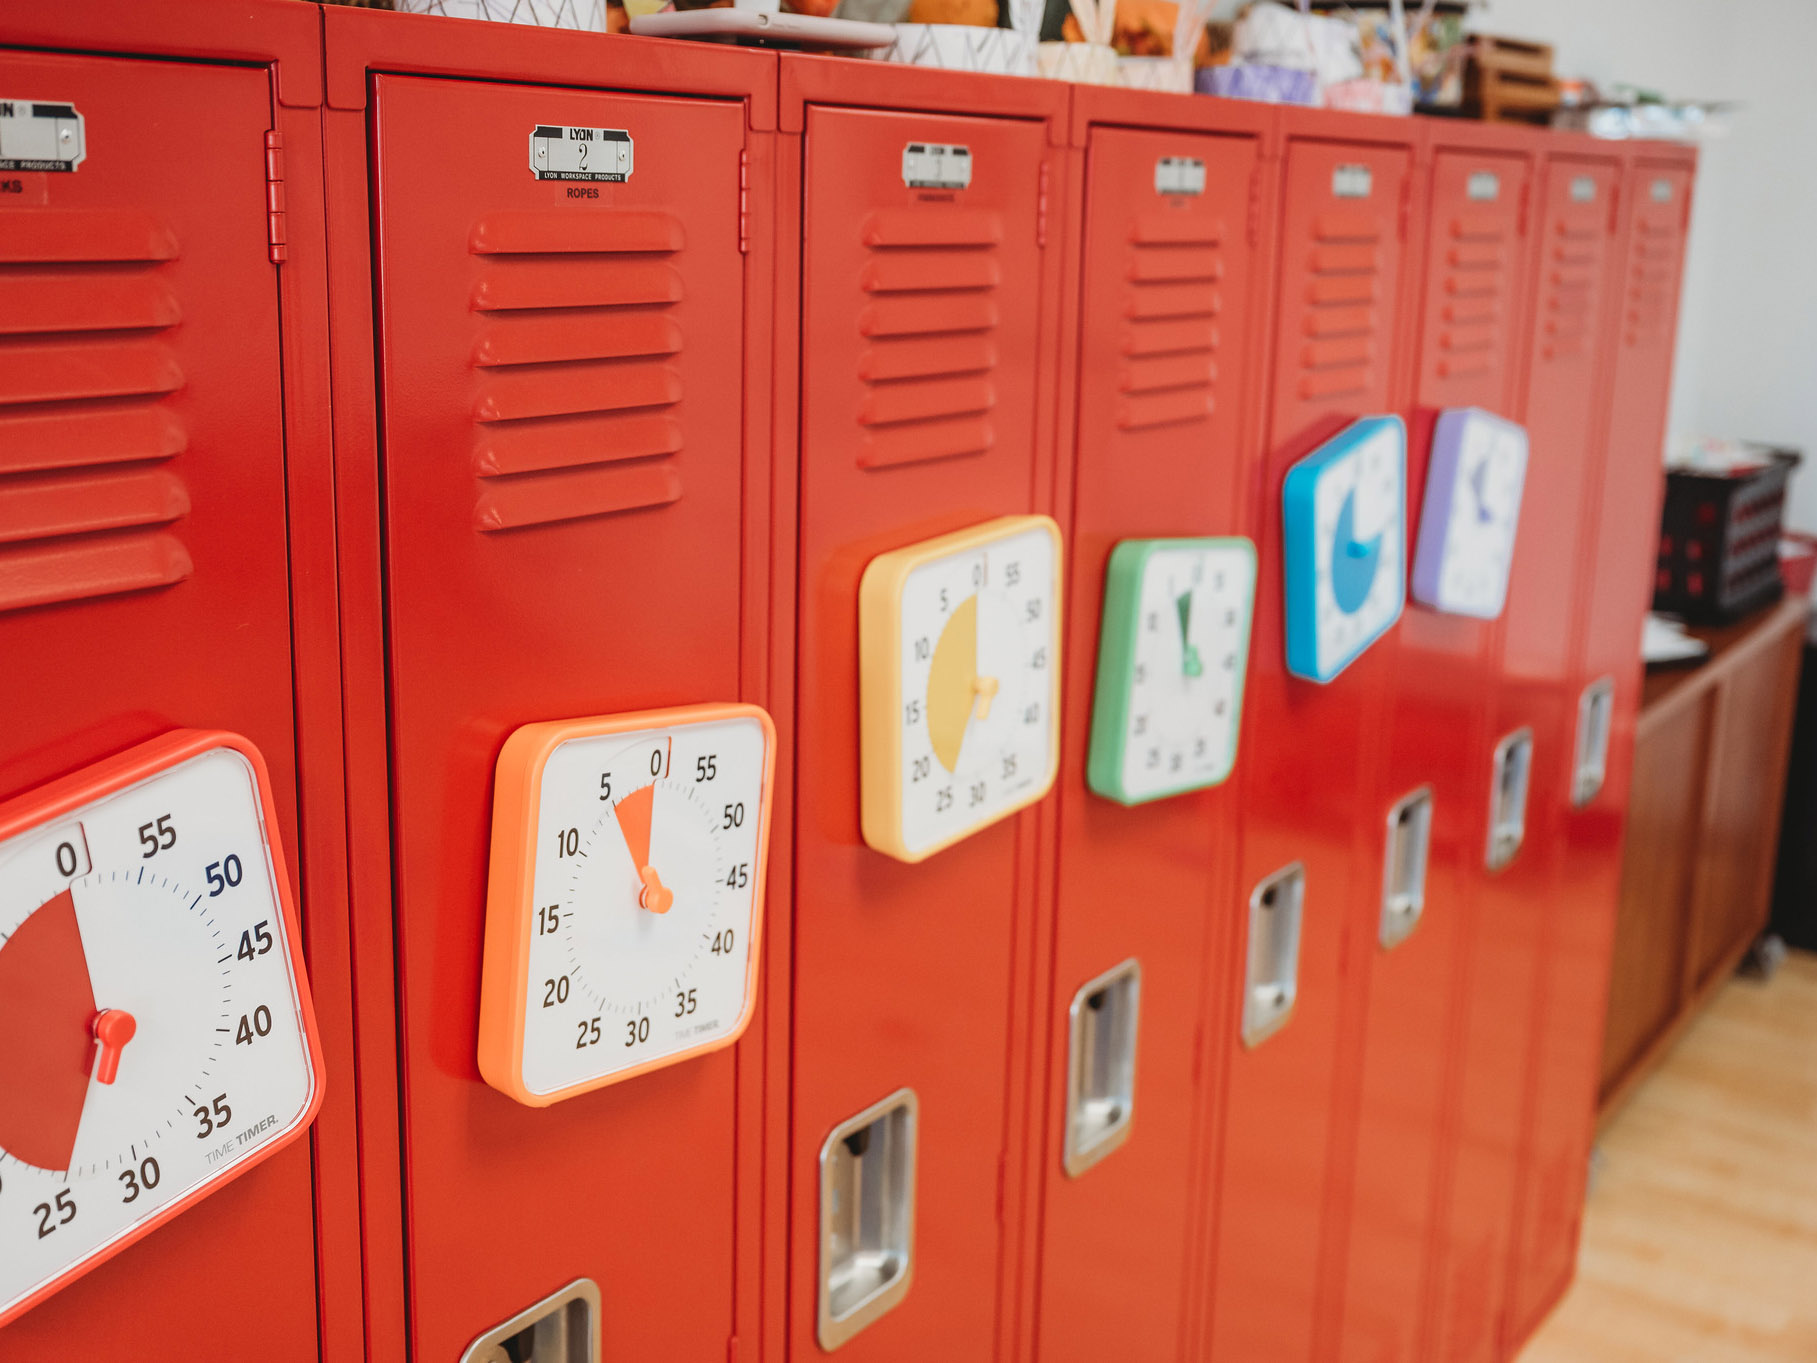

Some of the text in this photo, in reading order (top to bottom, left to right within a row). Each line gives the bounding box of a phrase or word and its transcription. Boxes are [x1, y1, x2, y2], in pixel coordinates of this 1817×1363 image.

[0, 103, 14, 117] N
[569, 128, 594, 141] LYON
[578, 143, 588, 171] 2
[560, 172, 592, 180] WORKSPACE
[594, 172, 622, 181] PRODUCTS
[567, 187, 599, 199] ROPES
[650, 749, 662, 776] 0
[695, 754, 717, 783] 55
[599, 772, 612, 801] 5
[722, 802, 745, 830] 50
[138, 813, 177, 859] 55
[557, 827, 579, 859] 10
[55, 842, 78, 877] 0
[204, 853, 244, 898] 50
[726, 863, 749, 890] 45
[538, 904, 560, 936] 15
[236, 919, 274, 962] 45
[711, 928, 735, 956] 40
[542, 975, 570, 1009] 20
[674, 988, 698, 1018] 35
[235, 1004, 273, 1046] 40
[575, 1016, 602, 1050] 25
[624, 1016, 650, 1048] 30
[192, 1092, 233, 1140] 35
[204, 1139, 236, 1165] TIME
[117, 1156, 161, 1204] 30
[32, 1187, 78, 1240] 25
